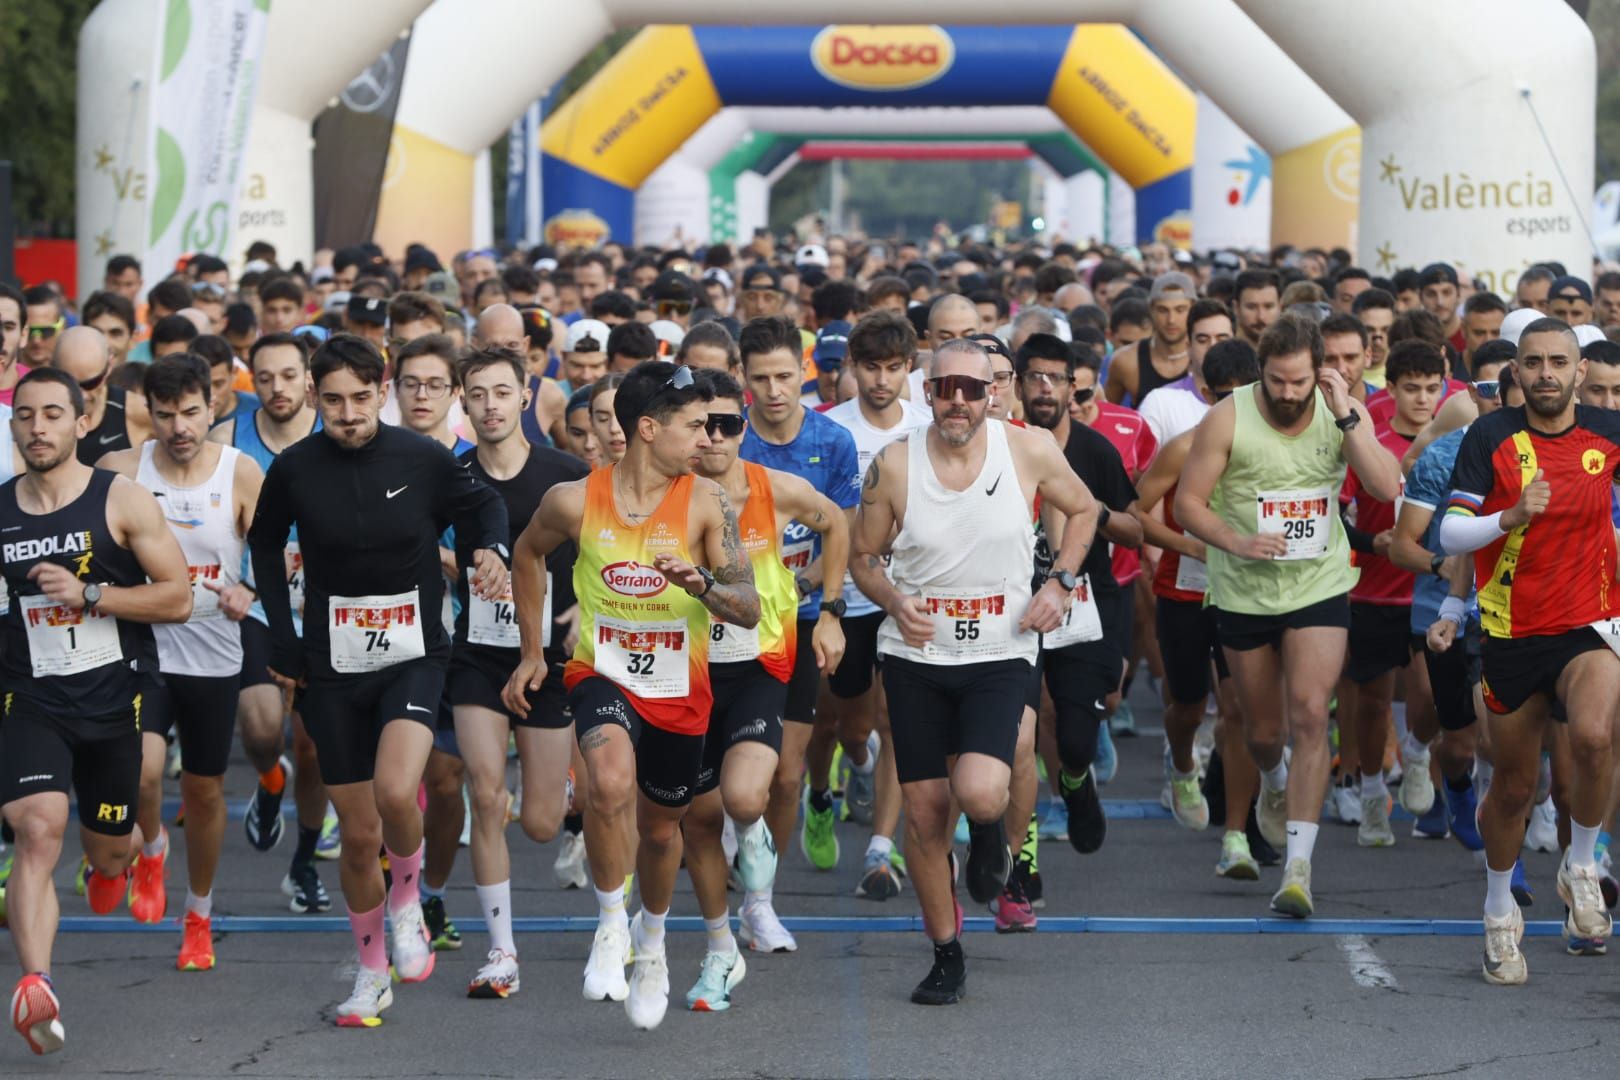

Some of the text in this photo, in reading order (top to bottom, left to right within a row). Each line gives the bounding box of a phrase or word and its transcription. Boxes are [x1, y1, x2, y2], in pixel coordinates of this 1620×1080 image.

[831, 36, 938, 65] Dacsa
[1400, 172, 1553, 211] València
[240, 208, 286, 228] ports
[1506, 215, 1571, 239] esports
[1283, 519, 1315, 539] 295
[3, 531, 86, 563] REDOLAT
[608, 569, 663, 588] Serrano
[646, 603, 671, 612] CORRE
[67, 626, 76, 650] 1
[365, 630, 391, 652] 74
[709, 623, 725, 642] 8
[954, 619, 980, 641] 55
[626, 652, 655, 675] 32
[97, 803, 123, 823] R1
